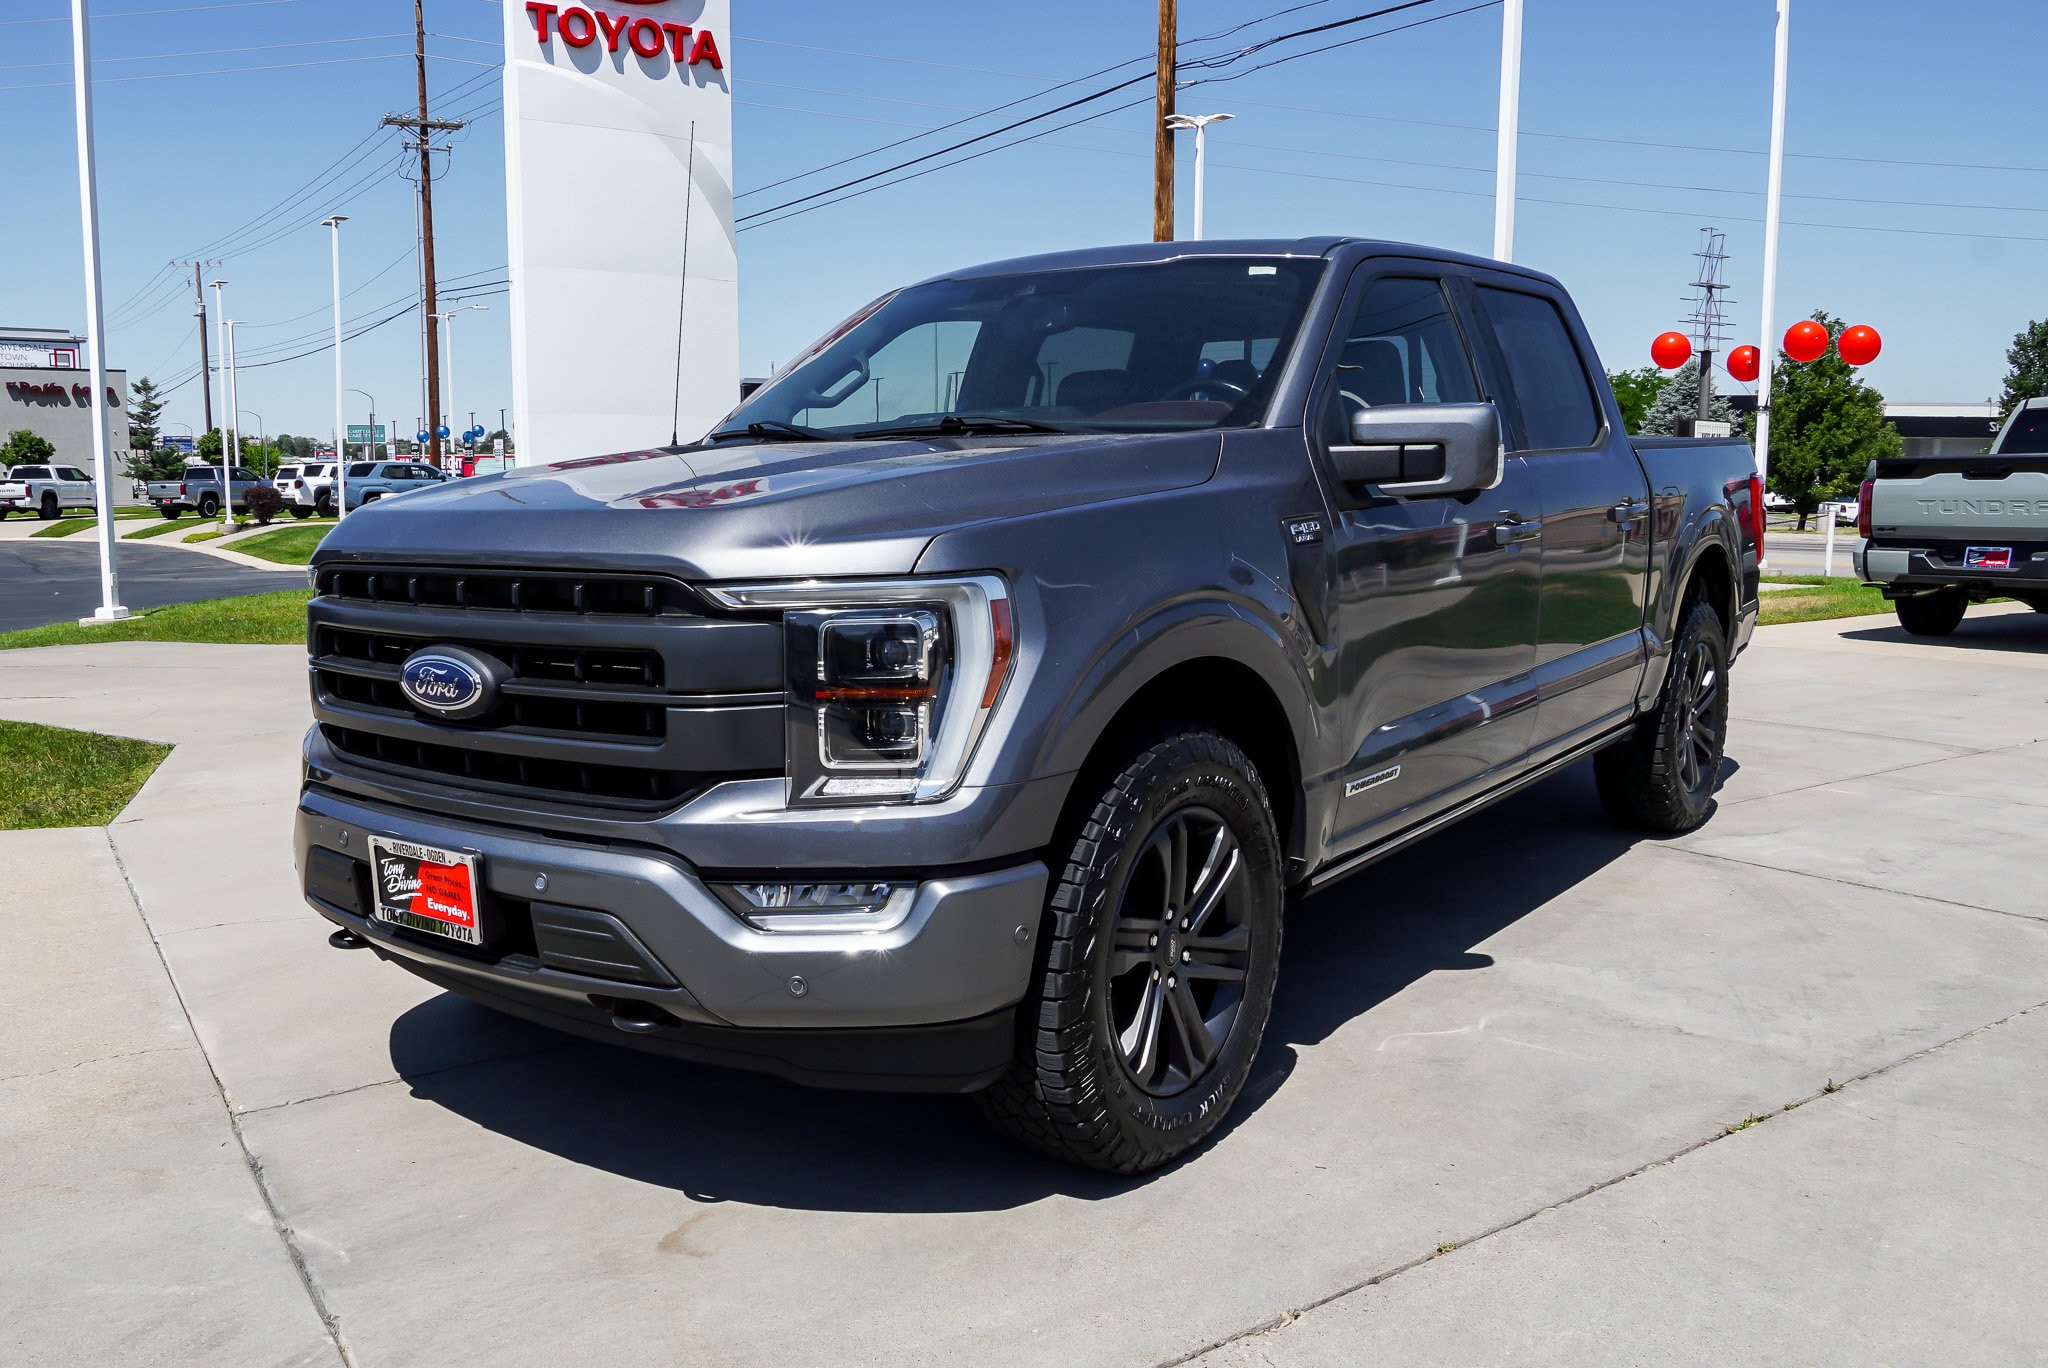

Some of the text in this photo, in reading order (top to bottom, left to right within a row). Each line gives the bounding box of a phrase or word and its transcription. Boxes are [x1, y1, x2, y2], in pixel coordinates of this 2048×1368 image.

[526, 1, 723, 69] TOYOTA
[0, 343, 49, 352] RIVERDALE
[0, 353, 28, 361] TOWN
[416, 666, 459, 698] Ford
[1349, 767, 1399, 793] POWERBOOST
[392, 842, 446, 864] RIVERDALE OGDEN
[380, 857, 406, 881] Tony
[383, 874, 423, 893] Divino
[426, 885, 437, 894] NO
[381, 907, 404, 924] TONY
[406, 912, 436, 932] DIVINO
[427, 897, 470, 921] Everyday.
